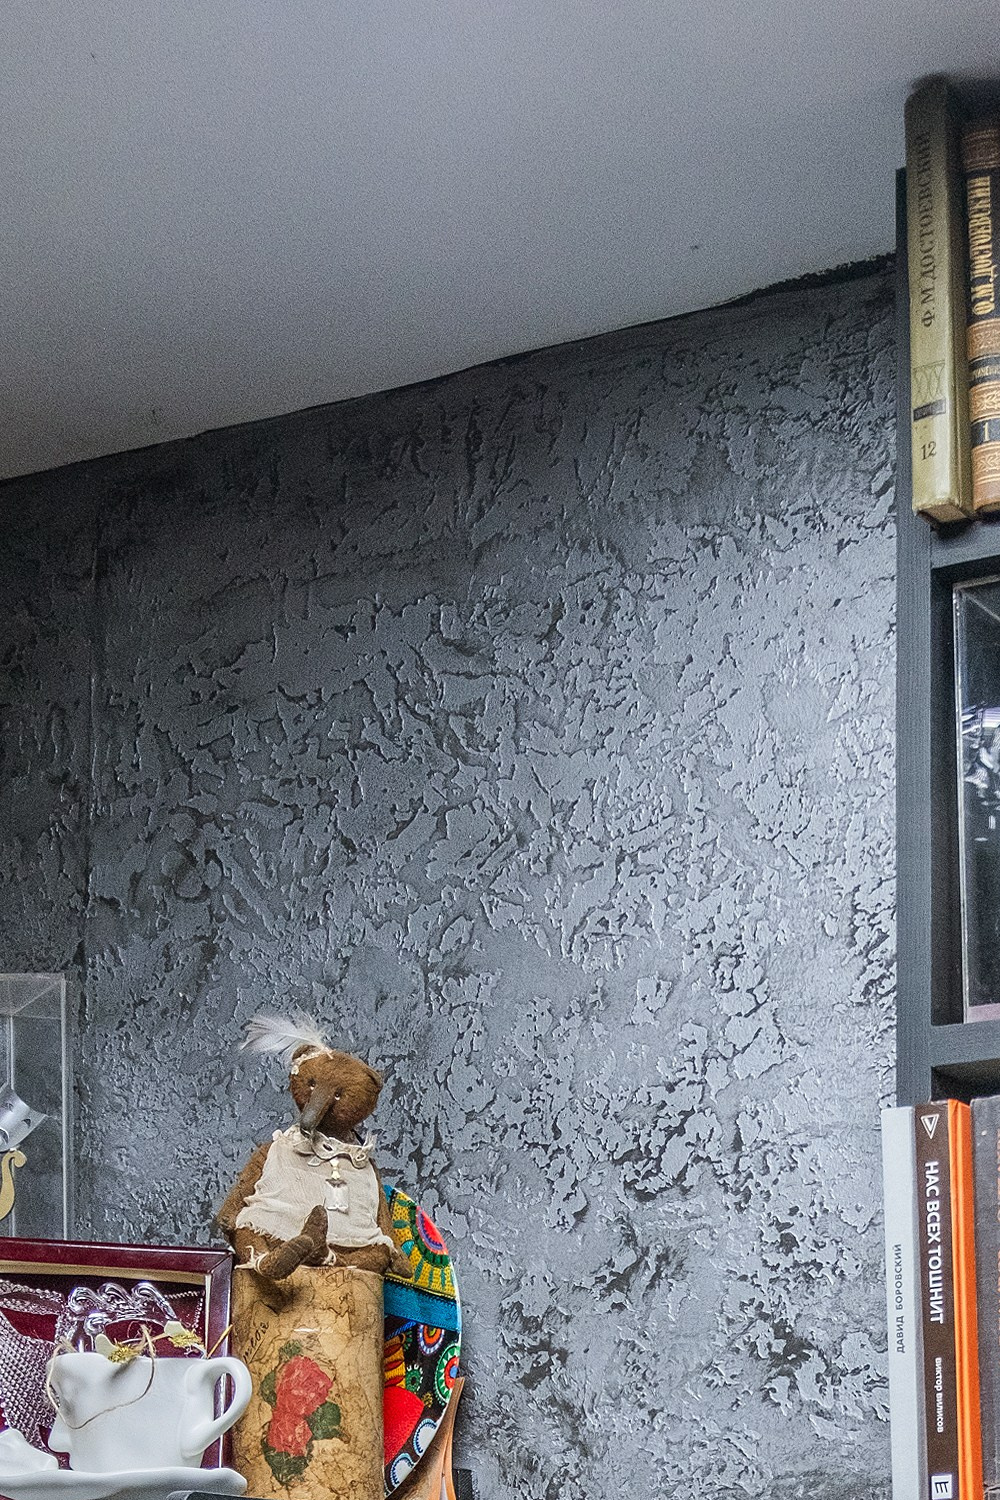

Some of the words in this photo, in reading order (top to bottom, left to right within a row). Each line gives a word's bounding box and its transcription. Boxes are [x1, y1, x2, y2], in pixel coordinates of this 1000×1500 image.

[920, 441, 937, 460] 12
[982, 422, 989, 442] 1
[924, 1160, 940, 1195] НАС
[925, 1198, 941, 1244] ВСЕХ
[894, 1243, 904, 1310] БОРОВСКИЙ
[927, 1247, 944, 1324] ТОШНИТ
[896, 1316, 906, 1354] ДАВИД
